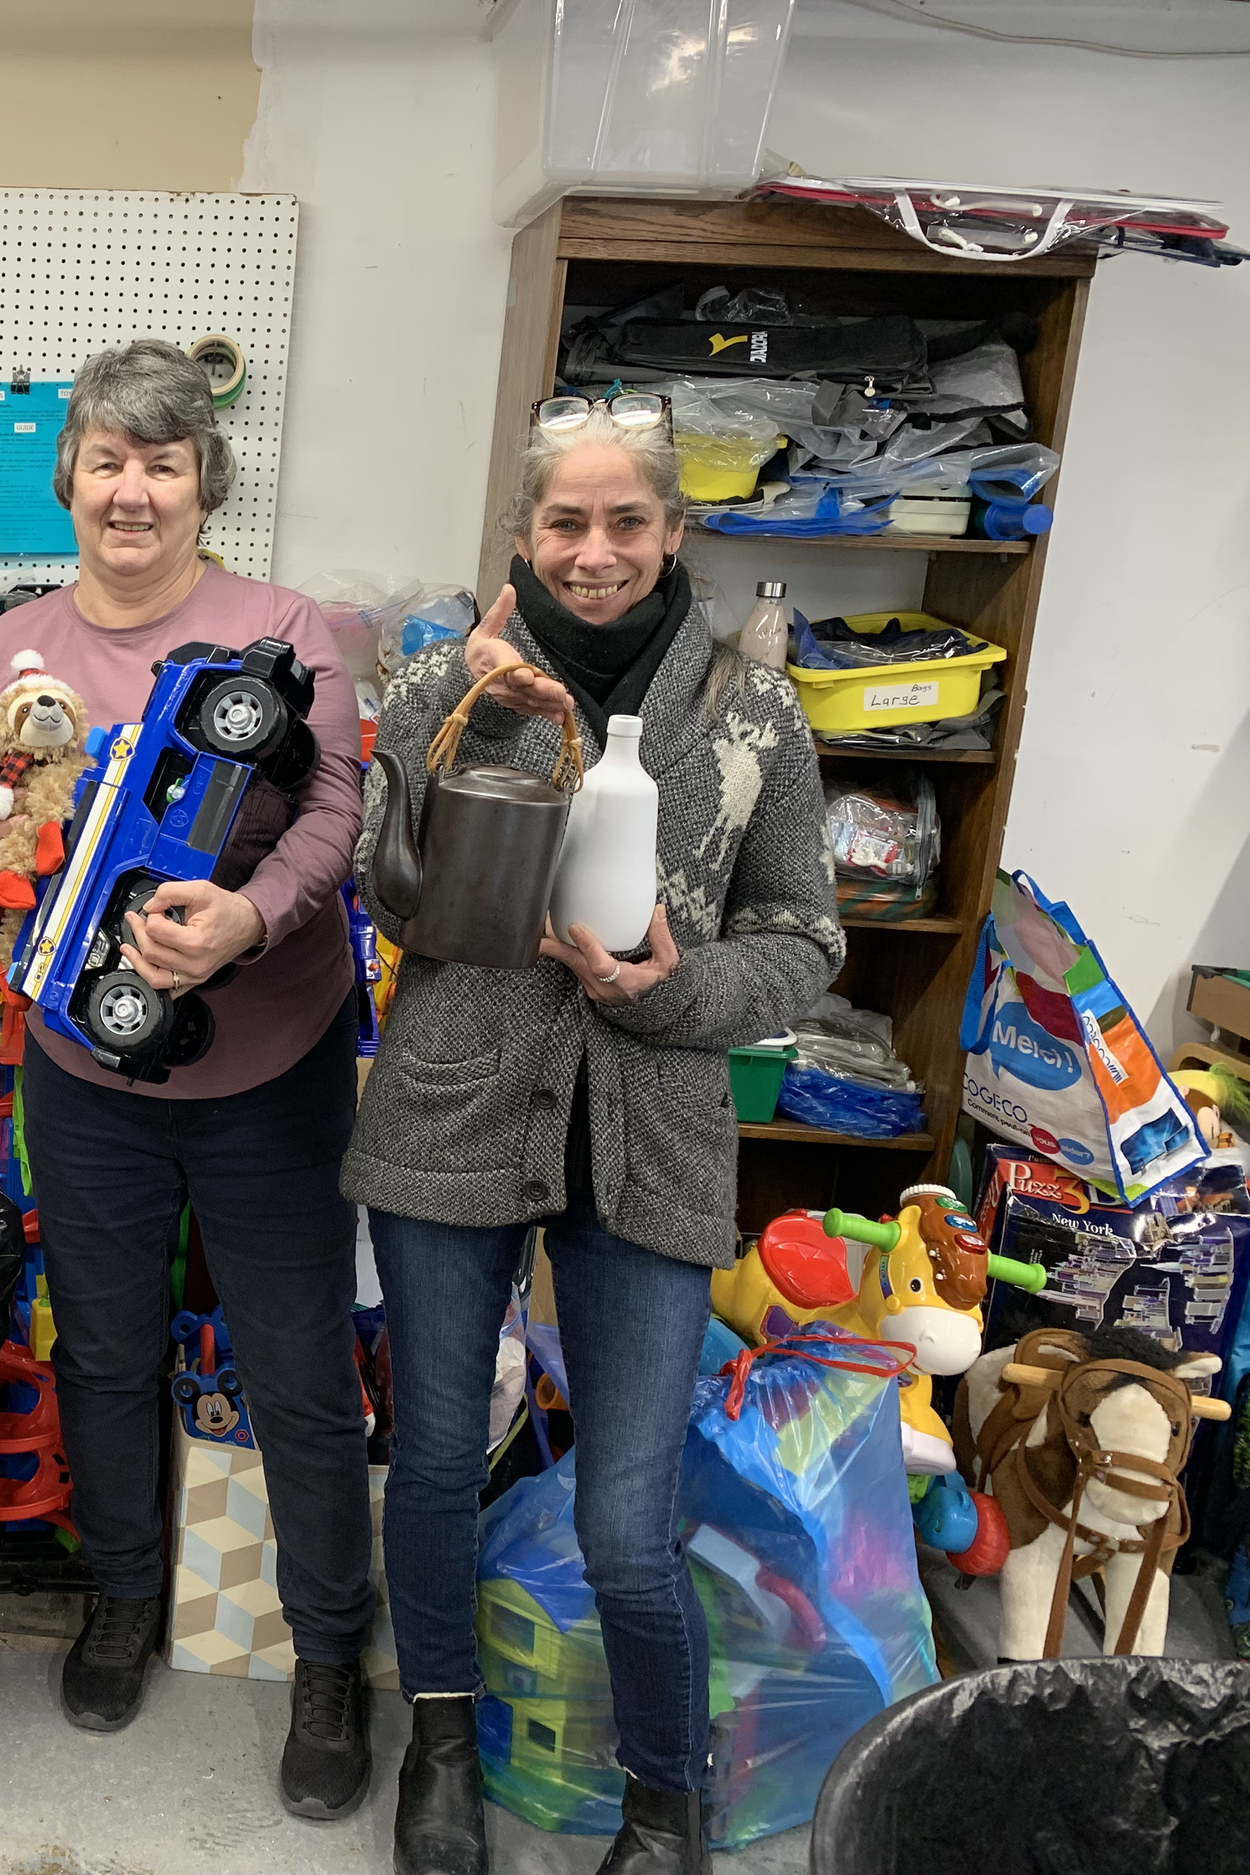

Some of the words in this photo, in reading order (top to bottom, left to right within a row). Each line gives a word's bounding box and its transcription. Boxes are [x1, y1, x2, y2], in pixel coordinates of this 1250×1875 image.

[750, 330, 768, 363] DIADORA
[870, 694, 921, 706] Large
[911, 684, 932, 692] Bags
[992, 1020, 1074, 1074] Merci!
[962, 1072, 1028, 1124] COGECO
[1006, 1161, 1063, 1200] Puzz
[1052, 1212, 1080, 1229] New
[1082, 1219, 1114, 1236] York
